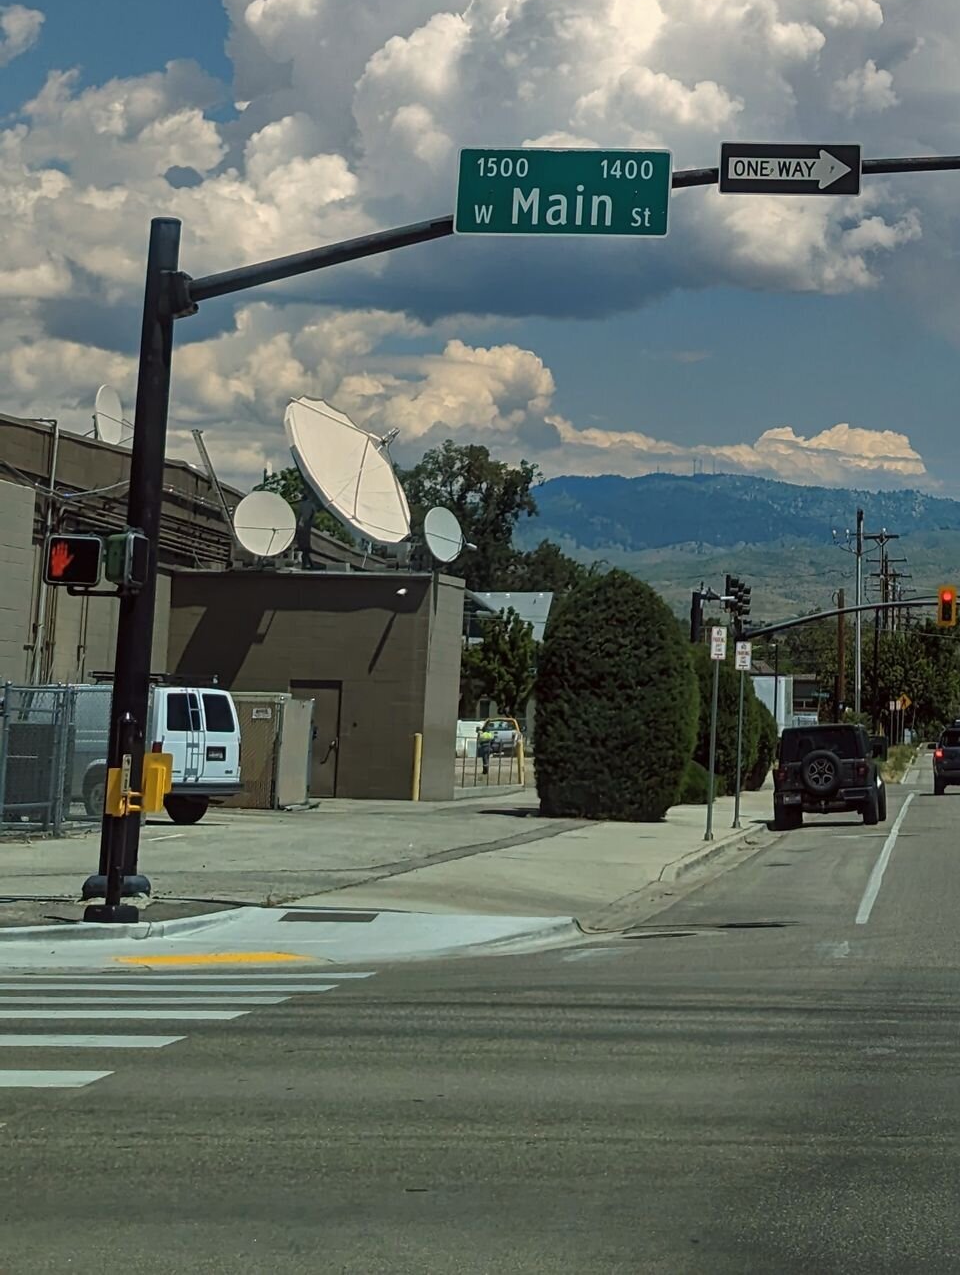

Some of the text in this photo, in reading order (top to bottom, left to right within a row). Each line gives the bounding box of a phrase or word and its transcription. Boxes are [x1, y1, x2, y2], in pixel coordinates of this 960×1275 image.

[477, 157, 654, 180] 1500 1400
[734, 159, 816, 178] ONE WAY
[474, 184, 652, 227] W Main St
